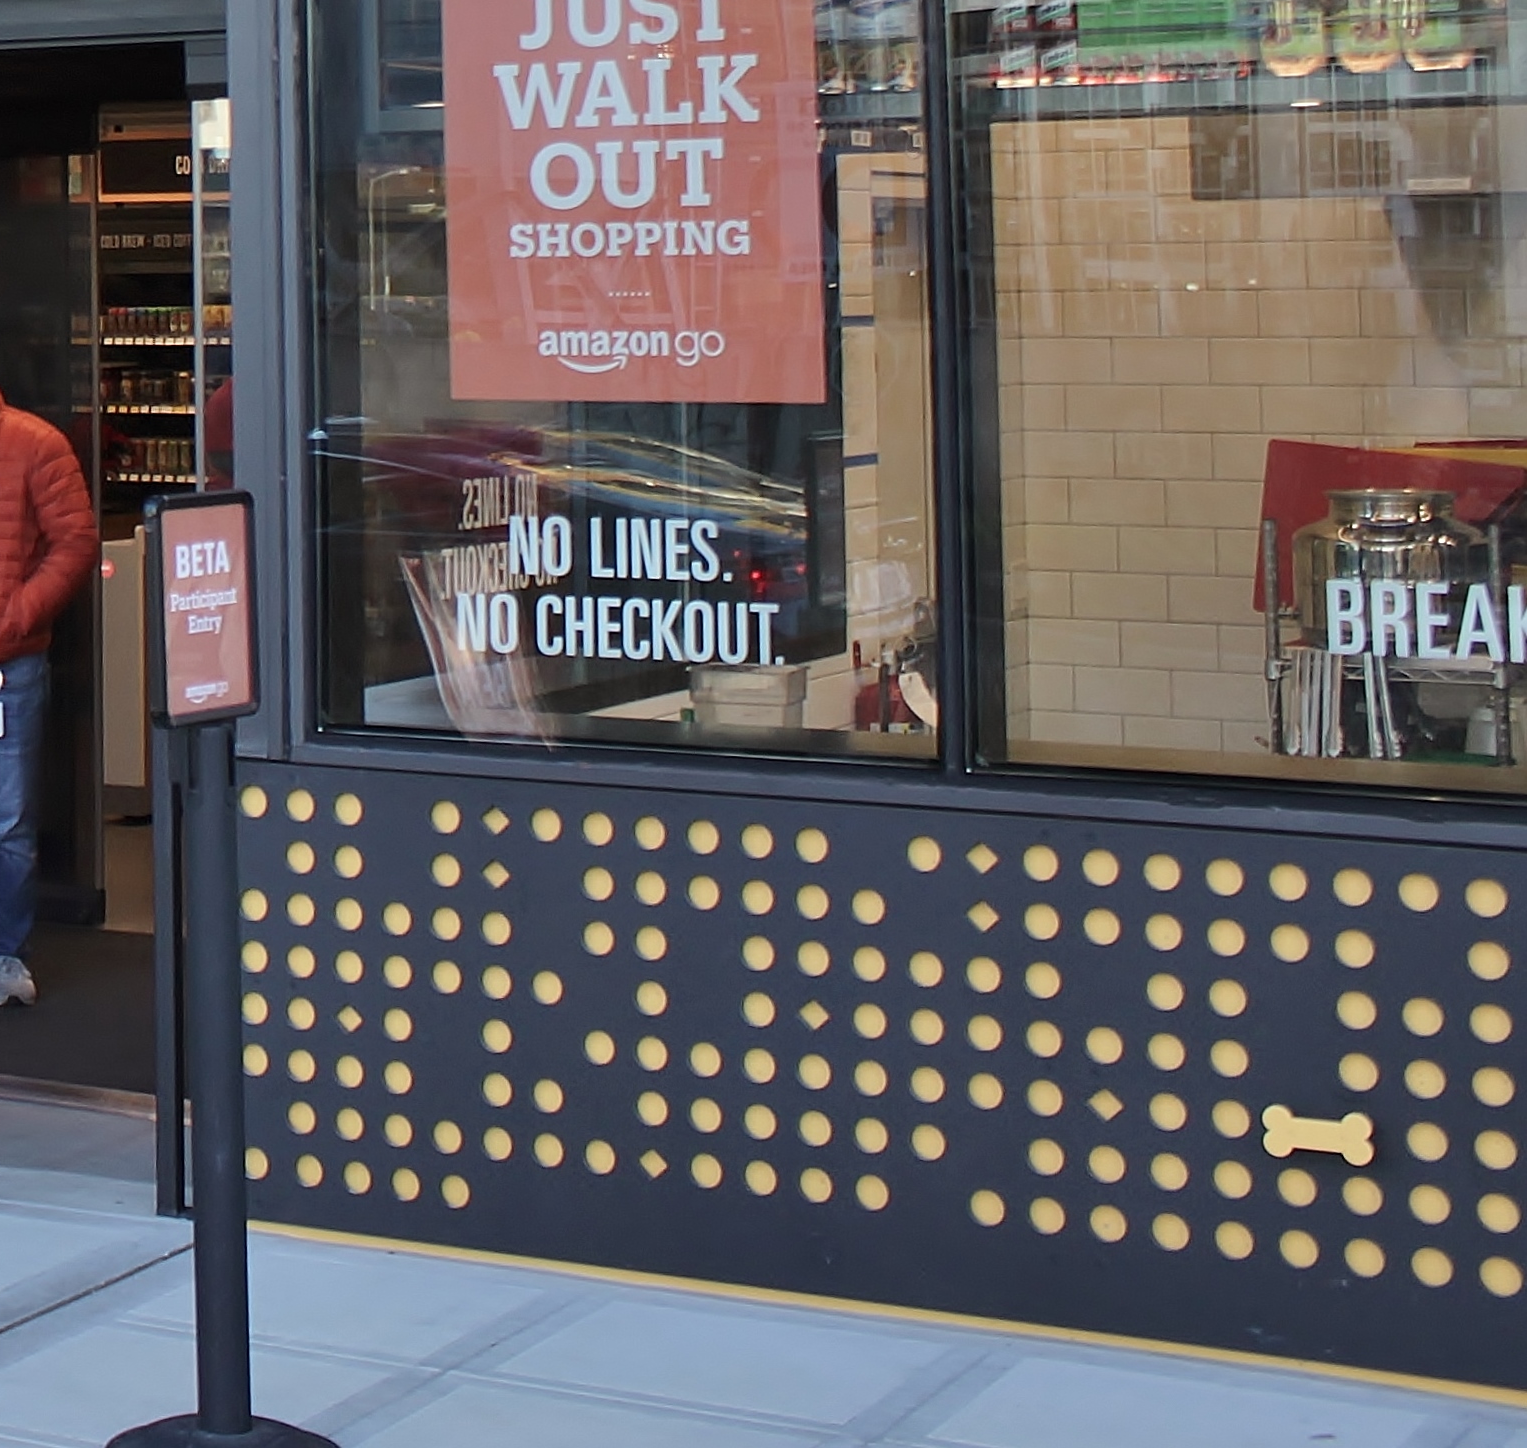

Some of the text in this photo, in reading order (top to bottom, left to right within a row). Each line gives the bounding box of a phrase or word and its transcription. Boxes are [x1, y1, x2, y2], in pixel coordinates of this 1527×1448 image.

[492, 53, 760, 131] WALK
[528, 137, 724, 211] OUT
[508, 218, 751, 258] SHOPPING
[538, 328, 725, 367] amazon go
[175, 540, 231, 579] BETA
[509, 514, 573, 578] NO
[589, 516, 733, 583] LINES.
[170, 587, 238, 613] Participant
[187, 614, 223, 635] Entry
[456, 592, 785, 666] NO CHECKOUT.
